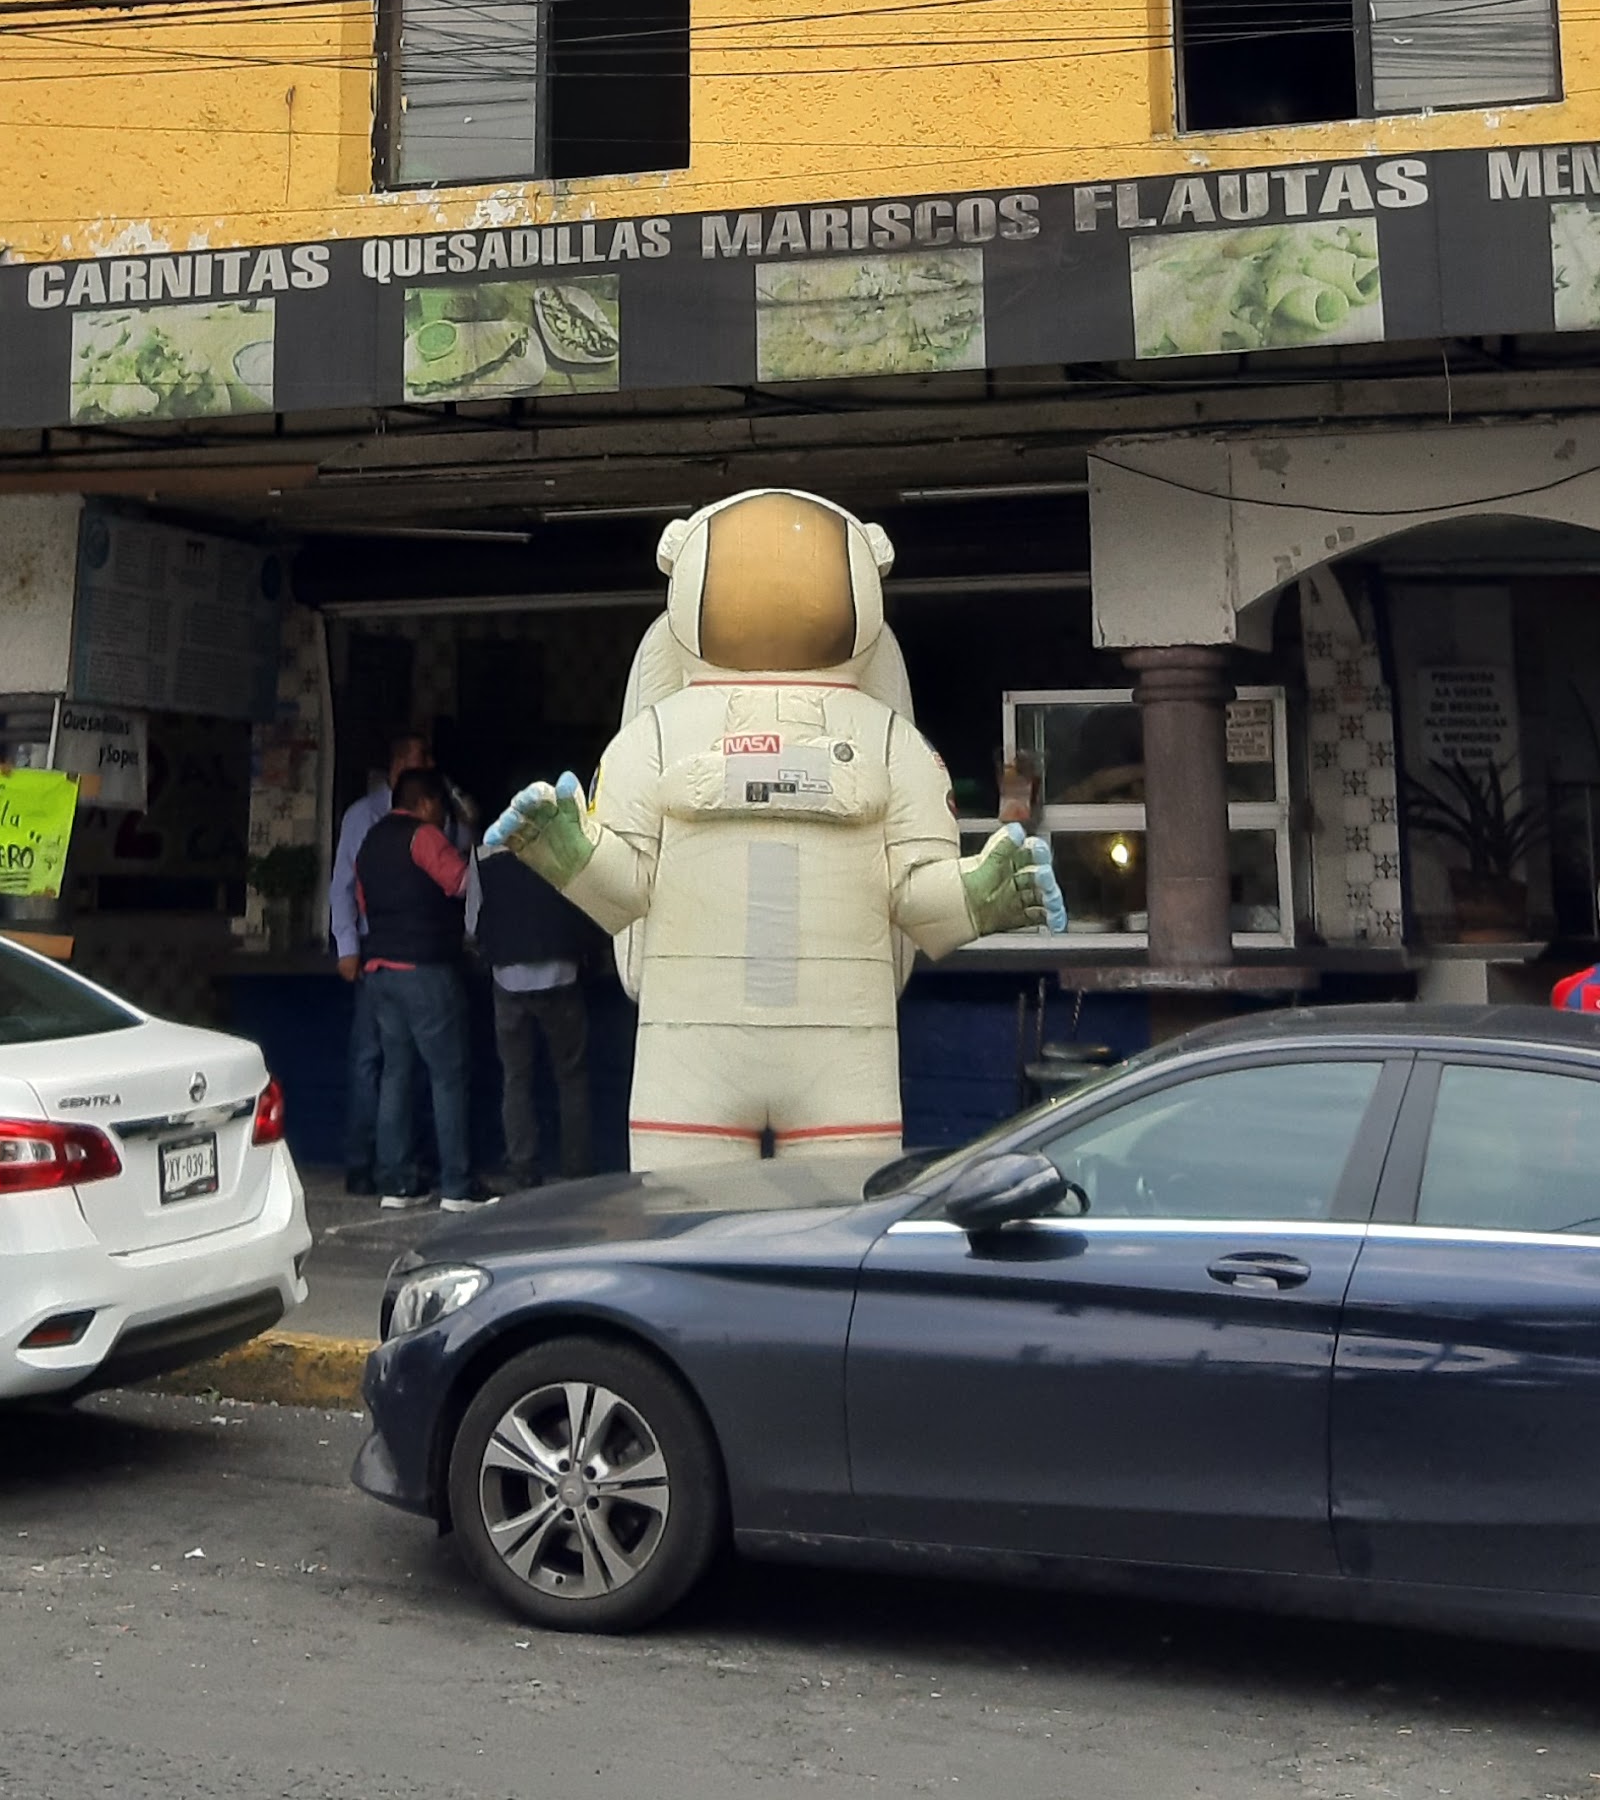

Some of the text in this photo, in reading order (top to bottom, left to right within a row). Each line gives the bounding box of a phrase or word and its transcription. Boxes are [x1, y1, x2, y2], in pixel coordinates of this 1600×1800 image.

[700, 192, 1041, 260] MARISCOS
[1074, 157, 1430, 232] FLAUTAS
[26, 244, 330, 310] CARNITAS
[361, 216, 672, 280] QUESADILLAS
[725, 736, 778, 754] NASA
